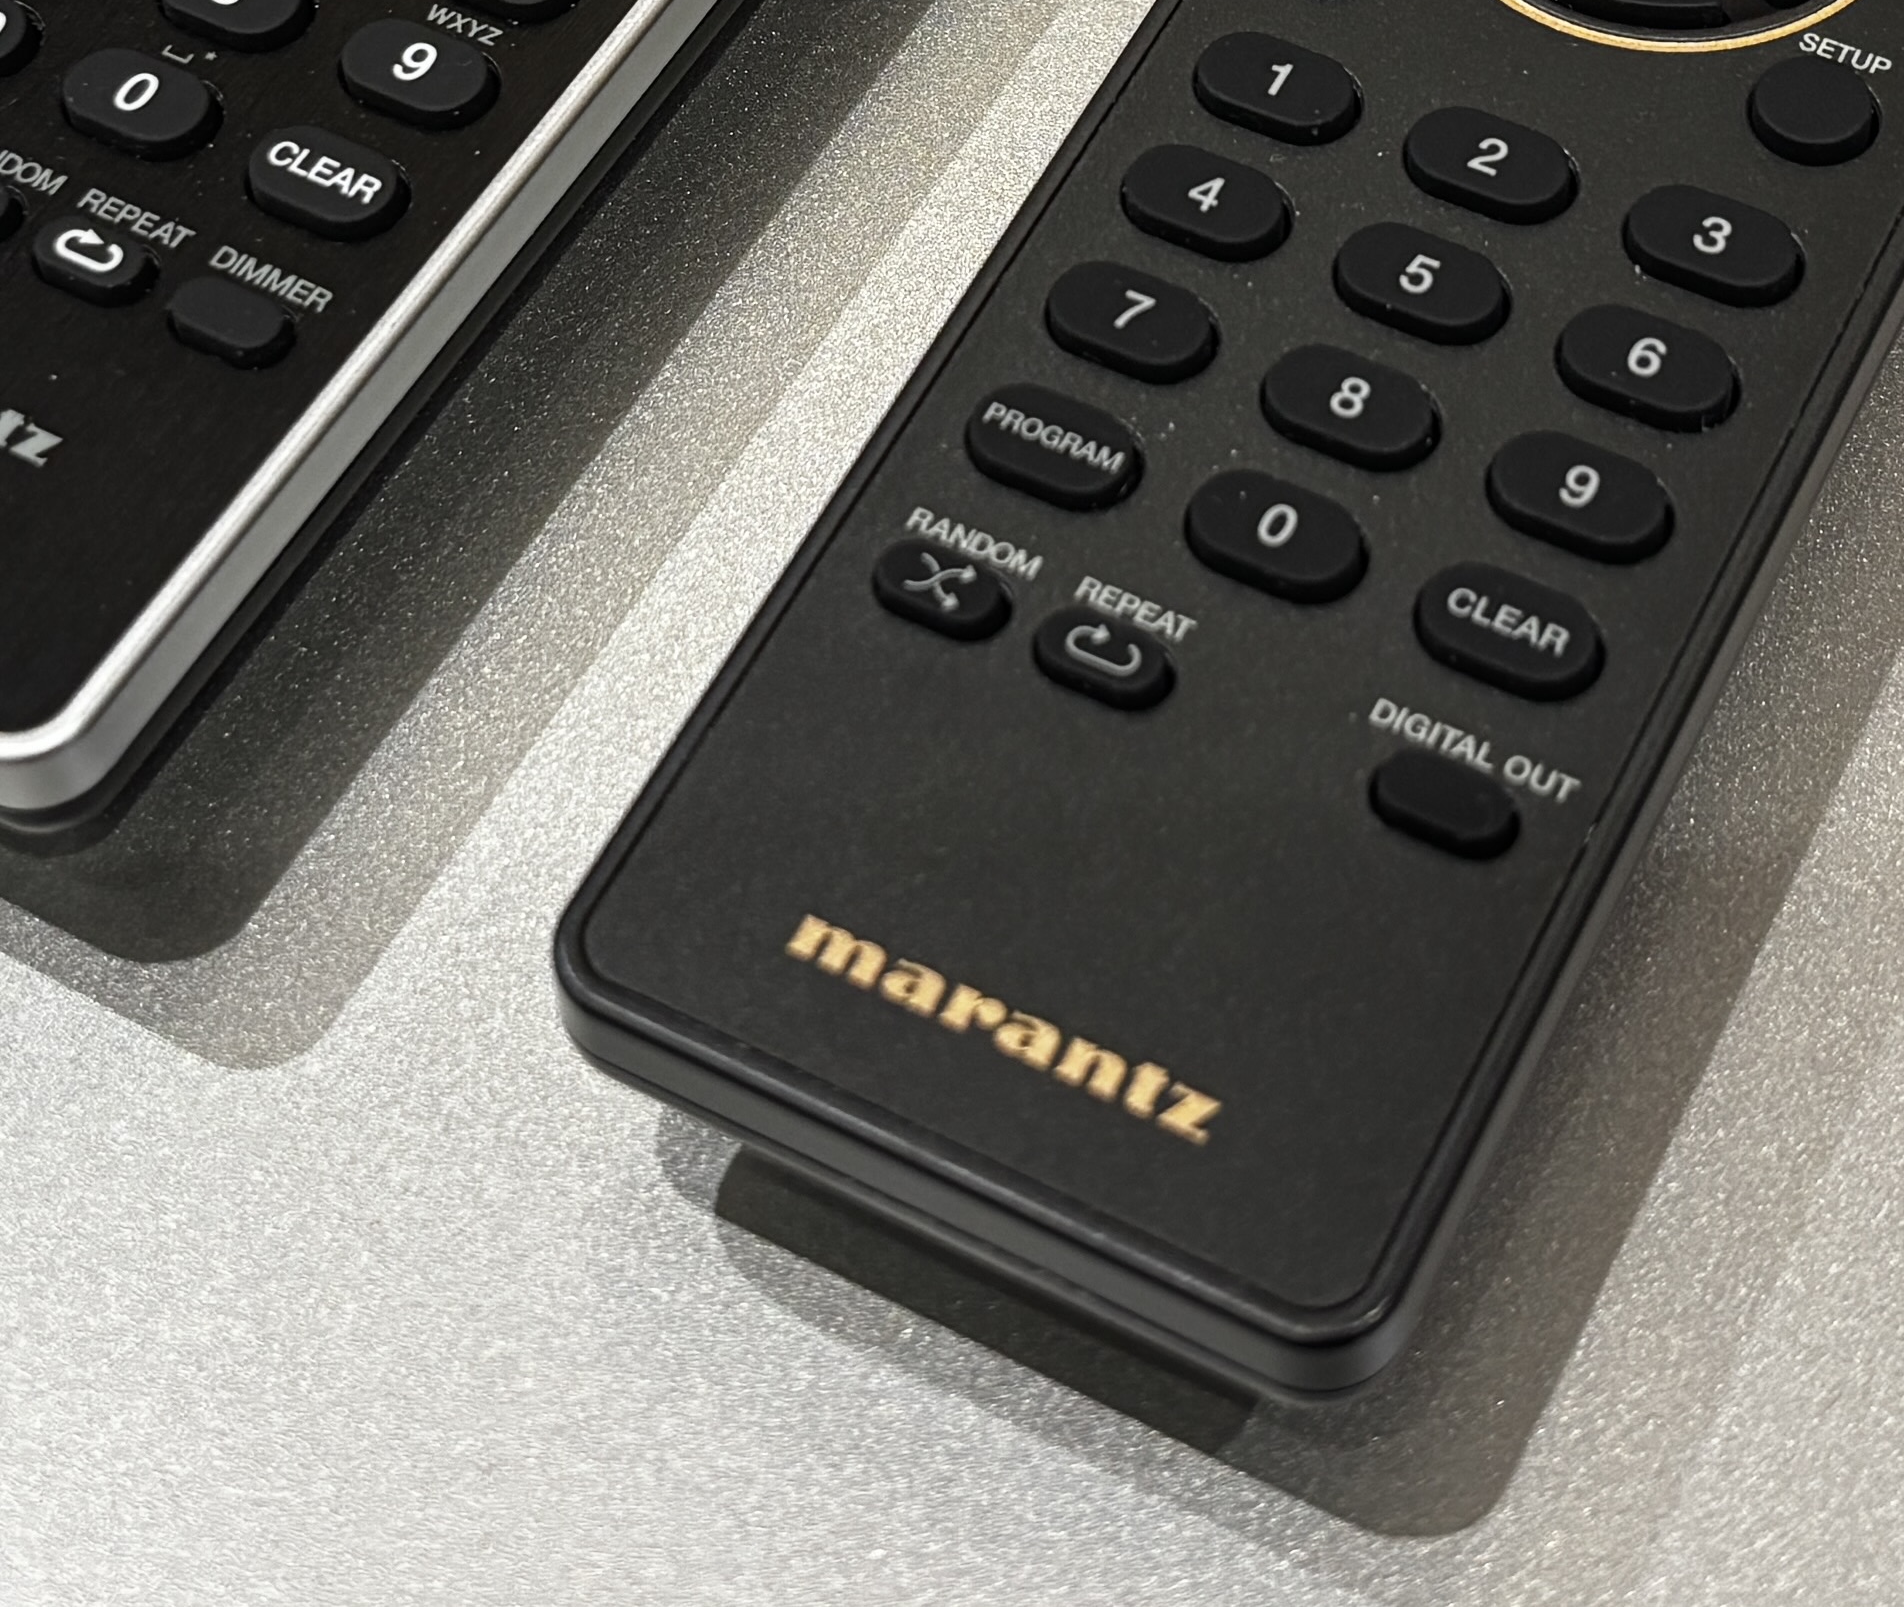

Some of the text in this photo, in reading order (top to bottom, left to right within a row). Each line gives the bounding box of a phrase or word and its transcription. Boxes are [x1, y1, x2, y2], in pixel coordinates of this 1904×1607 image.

[425, 3, 504, 47] WXYZ
[392, 43, 438, 82] 9
[1798, 31, 1893, 77] SETUP
[113, 72, 159, 112] 0
[1267, 64, 1295, 96] 1
[267, 140, 384, 206] CLEAR
[1468, 136, 1508, 176] 2
[1188, 177, 1227, 213] 4
[76, 187, 195, 249] REPEAT
[1693, 216, 1733, 255] 3
[209, 245, 333, 313] DIMMER
[1399, 254, 1441, 294] 5
[1113, 290, 1156, 329] 7
[1626, 337, 1668, 377] 6
[1330, 377, 1371, 418] 8
[982, 401, 1127, 475] PROGRAM
[1560, 466, 1601, 507] 9
[906, 506, 1044, 580] RANDOM
[1257, 504, 1298, 547] 0
[1073, 575, 1198, 643] REPEAT
[1446, 587, 1571, 657] CLEAR
[1366, 697, 1582, 805] DIGITAL OUT
[785, 914, 1223, 1144] marantz
